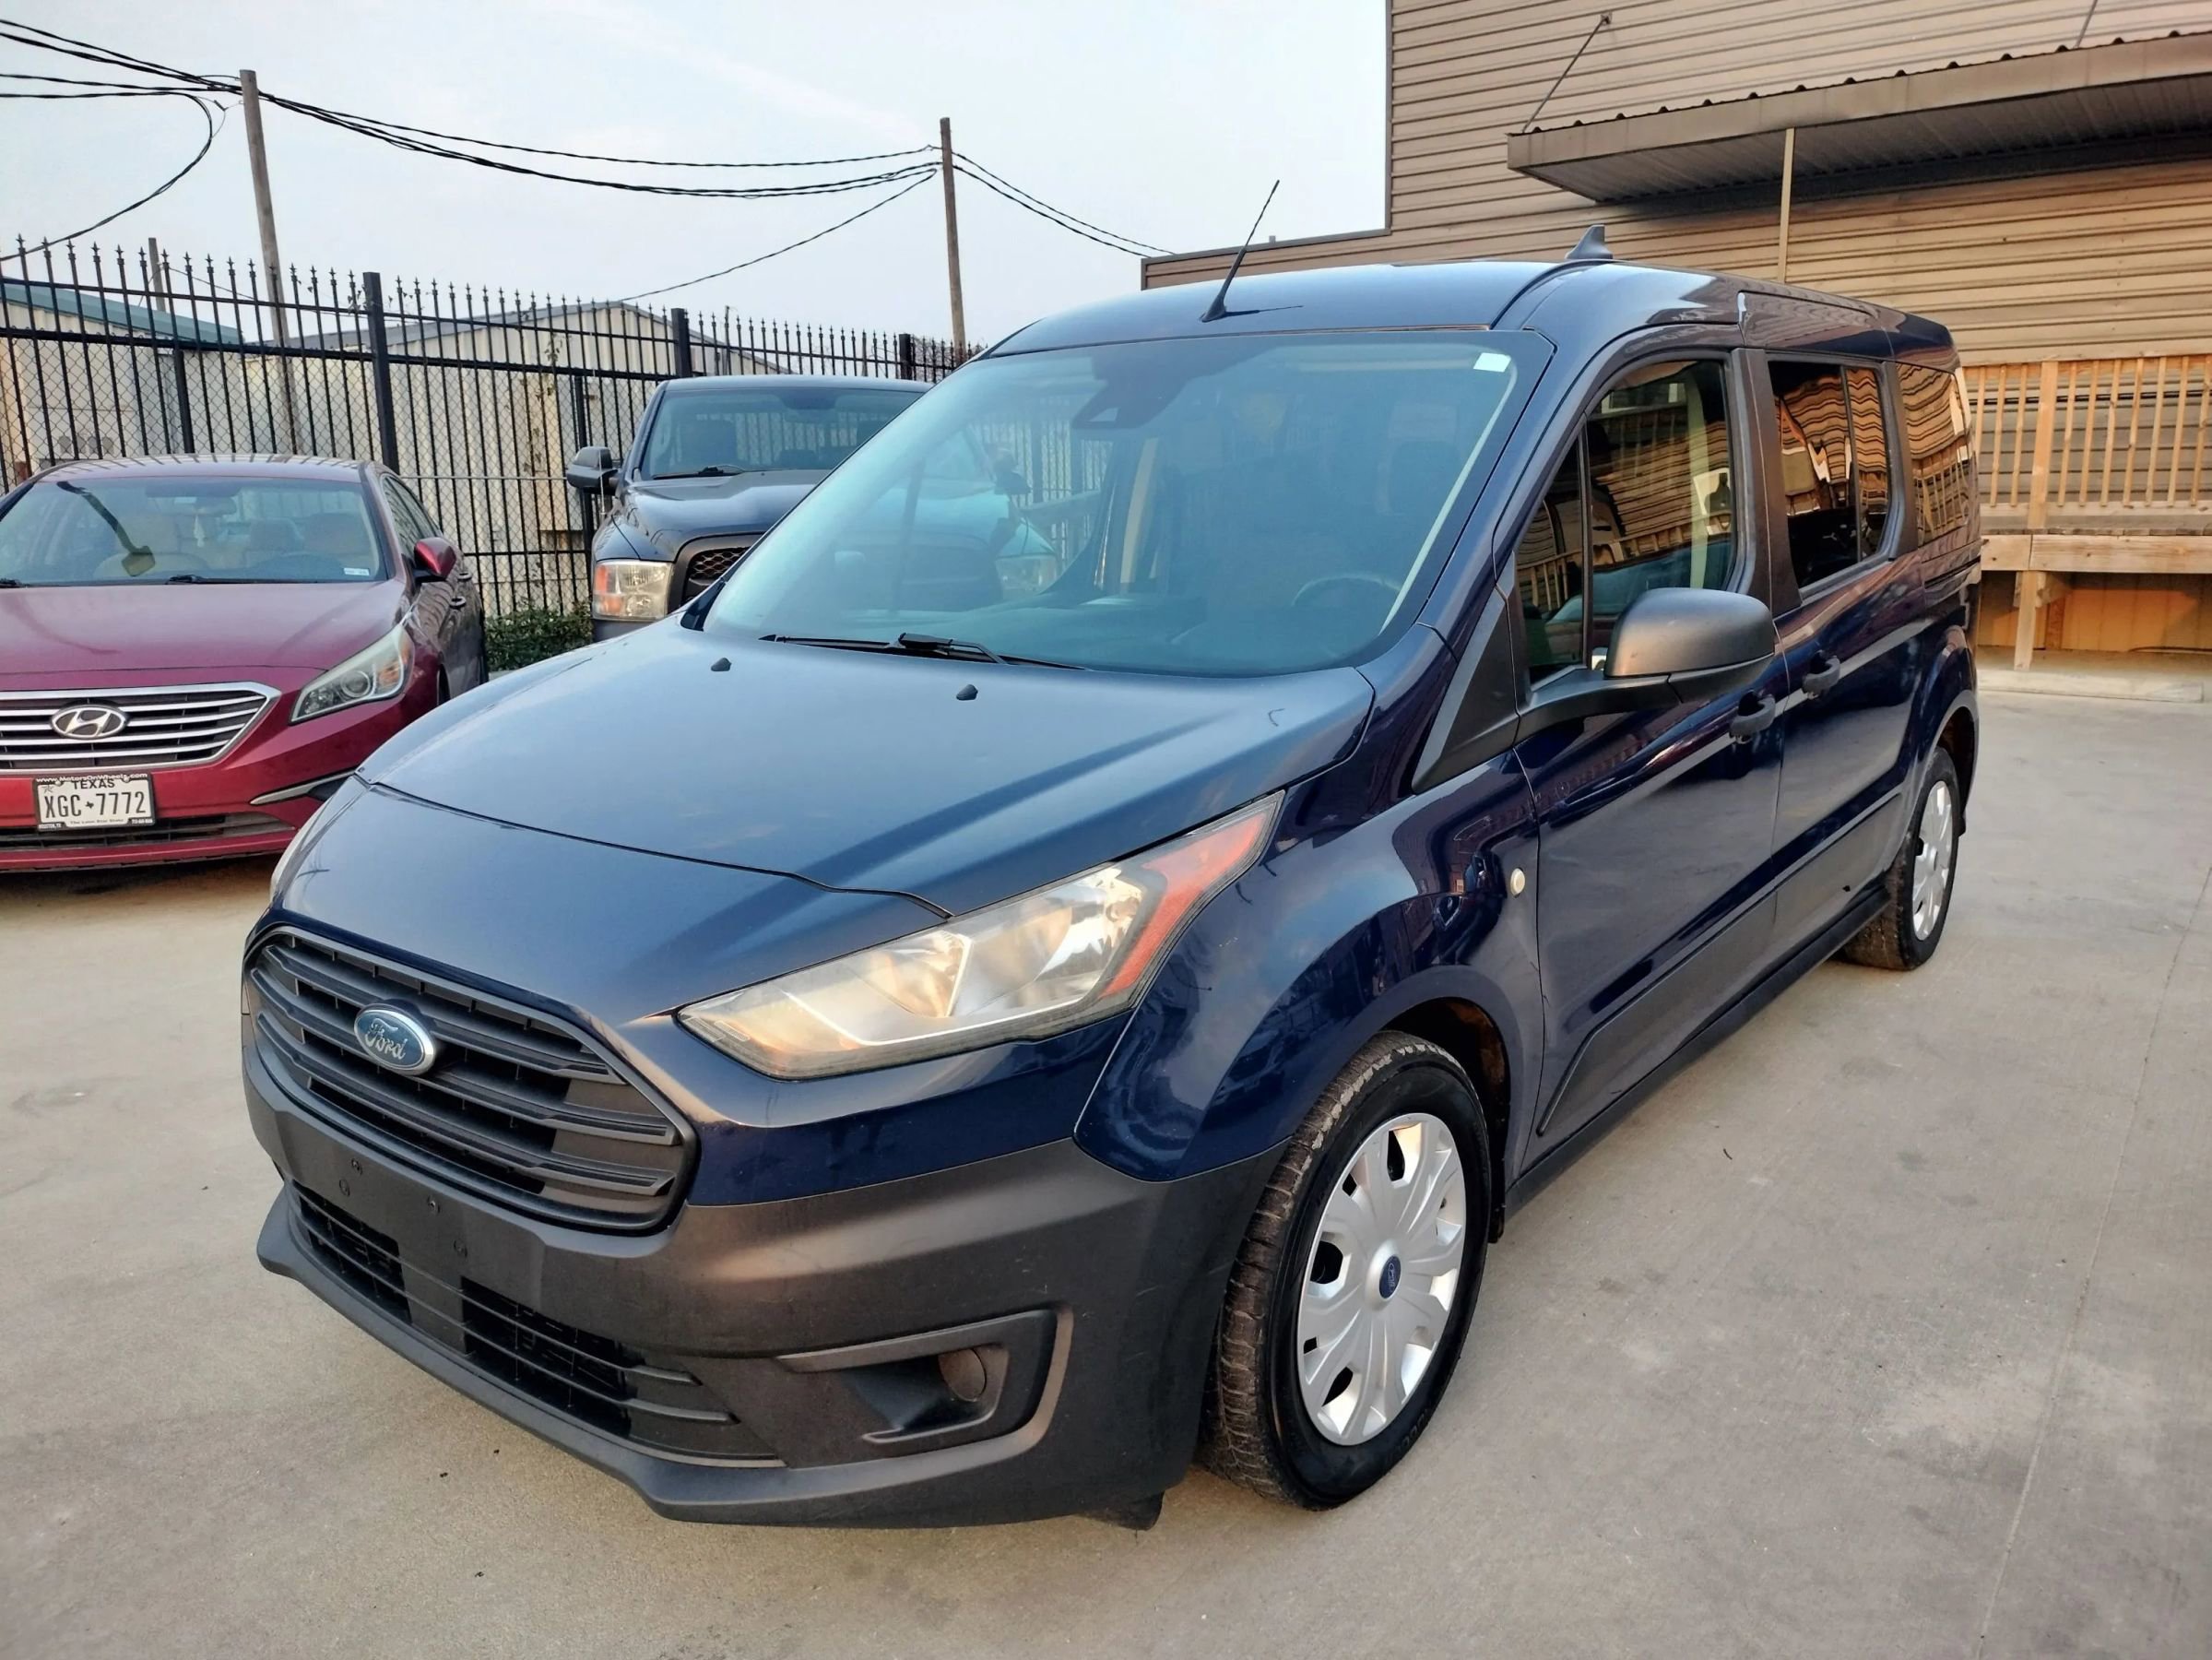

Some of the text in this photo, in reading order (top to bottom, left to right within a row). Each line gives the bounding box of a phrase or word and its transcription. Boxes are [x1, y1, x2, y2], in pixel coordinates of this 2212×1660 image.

[73, 777, 115, 789] TEXAS
[44, 791, 146, 818] XGC 7772
[364, 1017, 408, 1060] Ford
